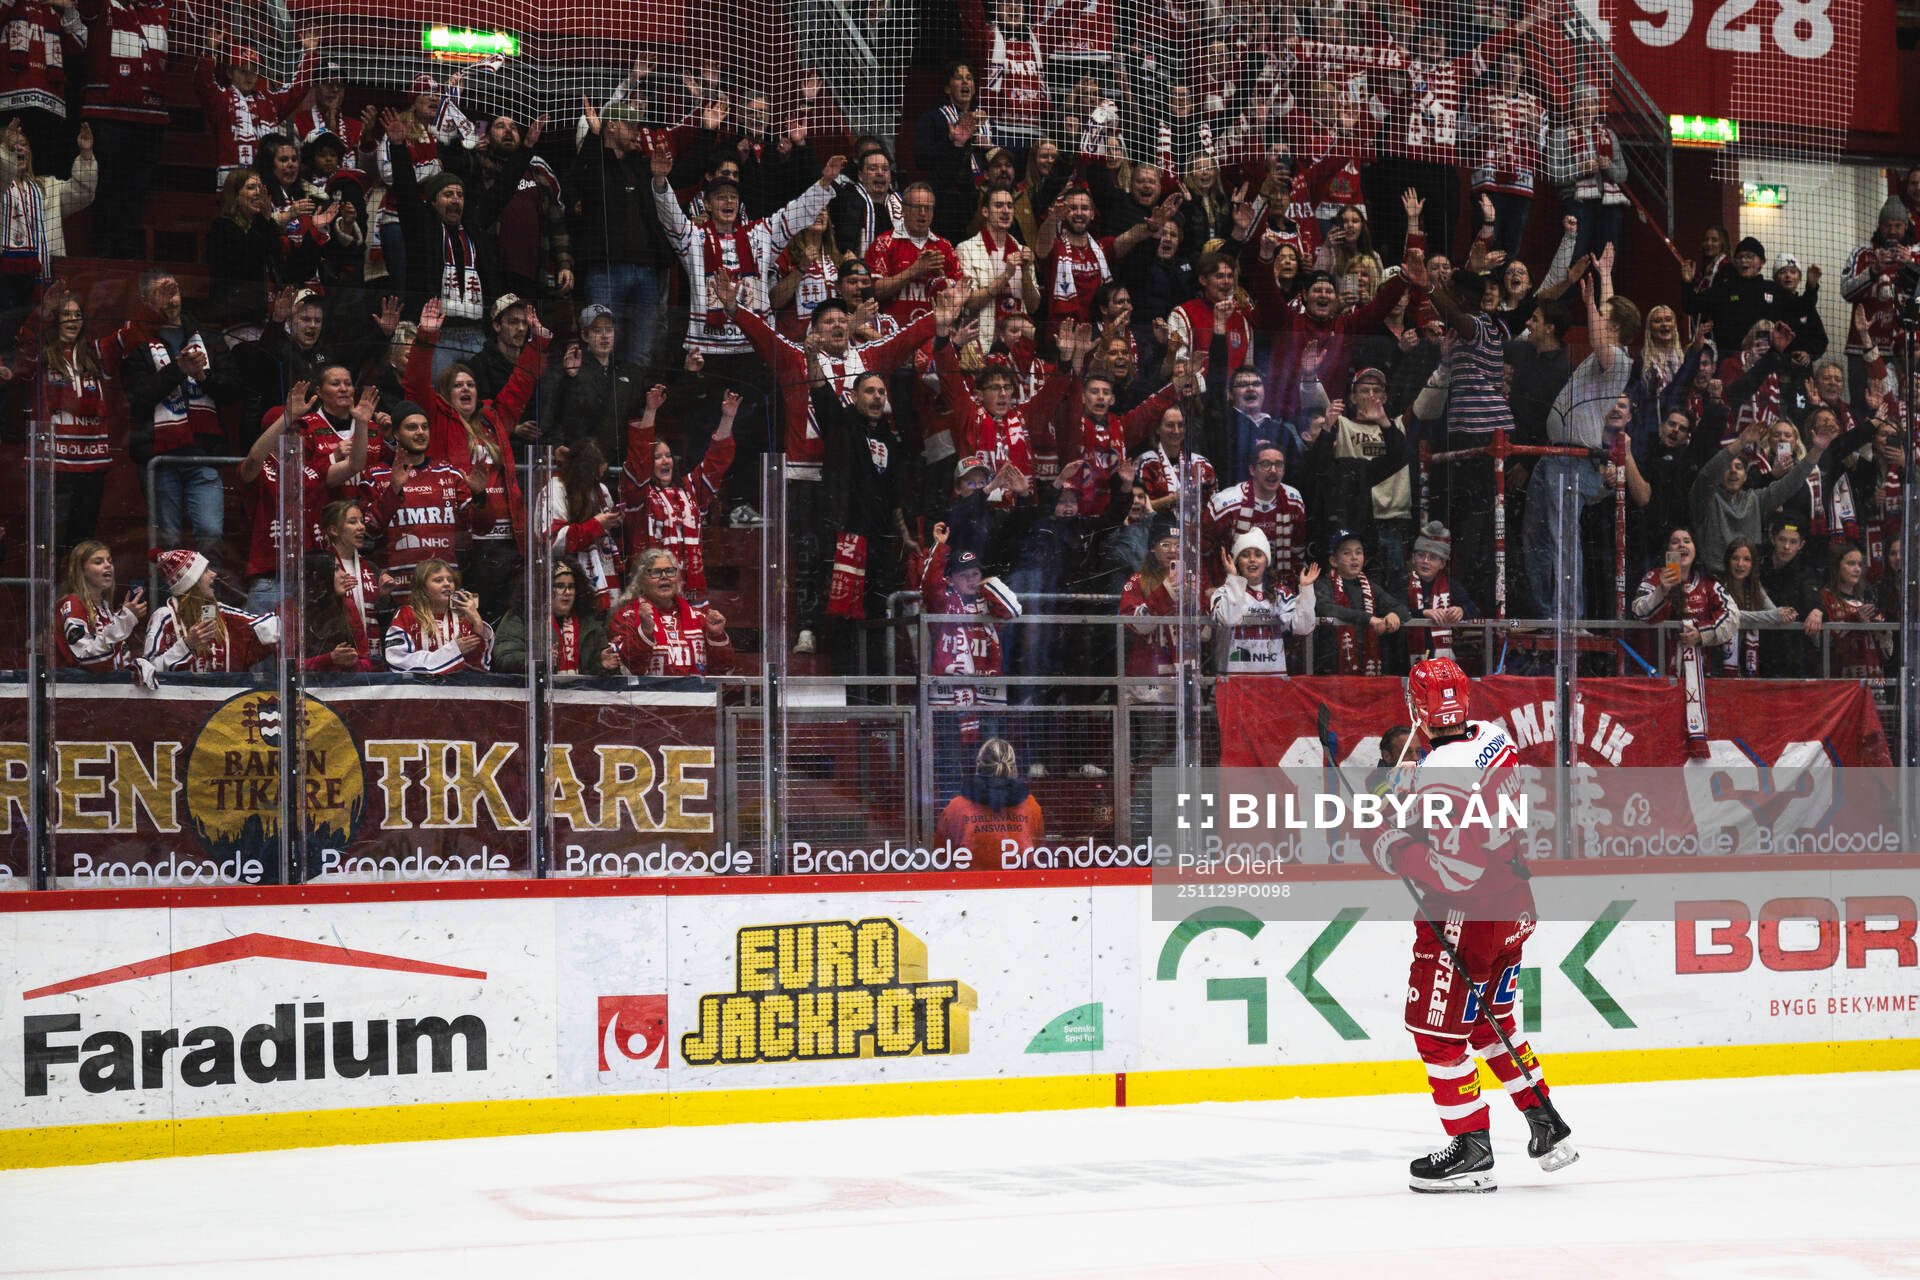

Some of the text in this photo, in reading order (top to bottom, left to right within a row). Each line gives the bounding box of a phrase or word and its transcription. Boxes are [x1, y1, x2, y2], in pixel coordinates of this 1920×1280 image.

[421, 537, 450, 549] NHC
[1252, 652, 1278, 663] NHC
[1441, 713, 1457, 726] 54
[1590, 712, 1634, 767] IK
[224, 749, 327, 778] BARN
[210, 777, 346, 812] TIKRE
[1622, 793, 1651, 827] 62
[737, 918, 900, 994] EURO
[1770, 995, 1917, 1017] BYGG BEKYMME
[681, 981, 959, 1066] JACKPOT
[23, 1001, 488, 1097] Faradium
